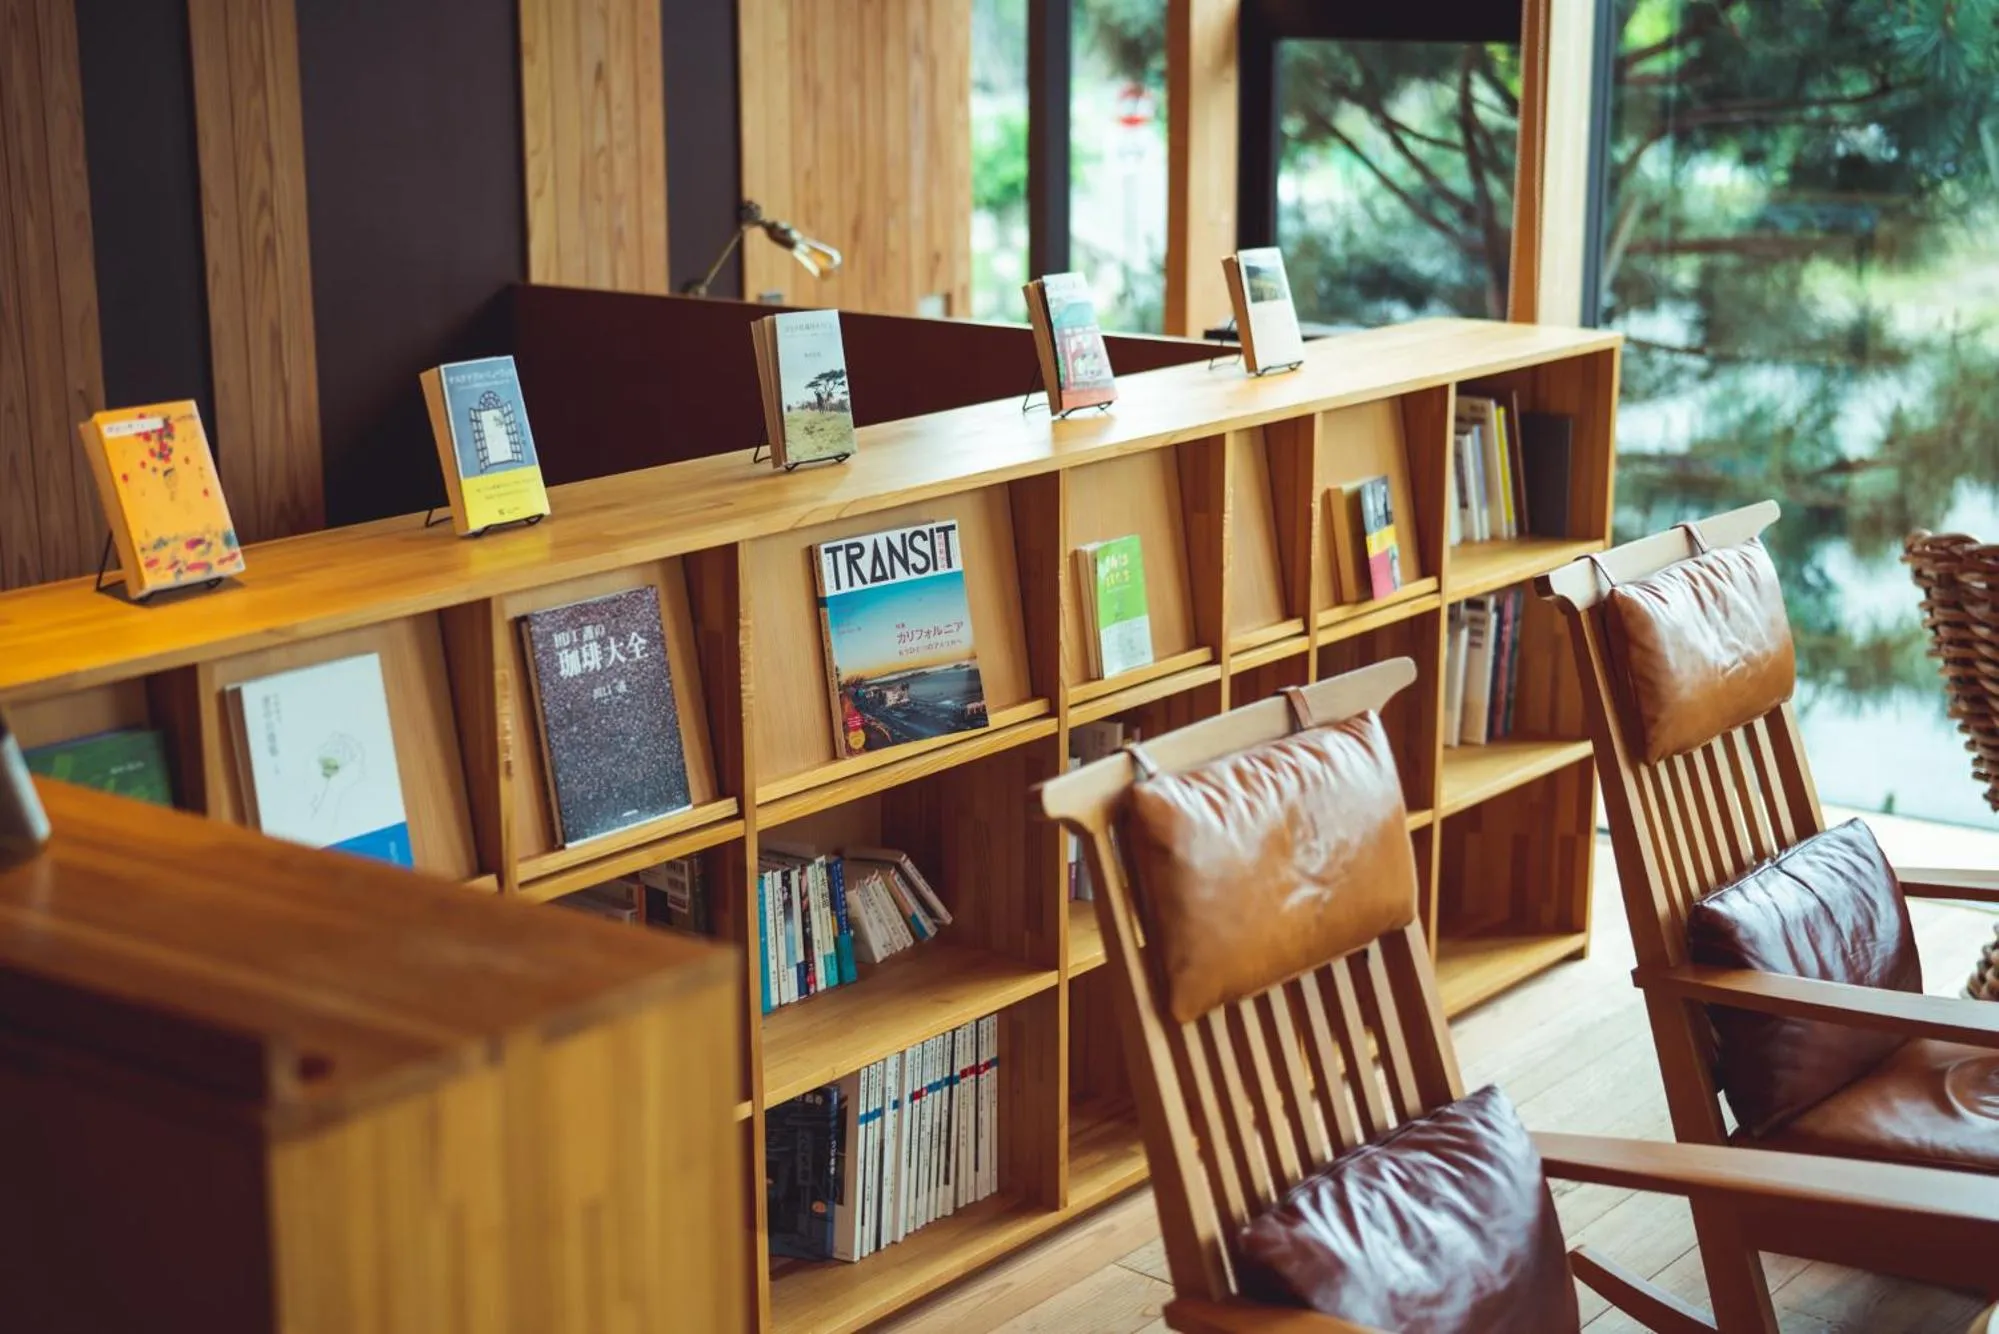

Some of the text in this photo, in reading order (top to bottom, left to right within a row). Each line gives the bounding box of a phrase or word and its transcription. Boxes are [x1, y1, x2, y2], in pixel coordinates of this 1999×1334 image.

[824, 524, 956, 591] TRANSIT
[896, 620, 964, 645] カリフォルニア
